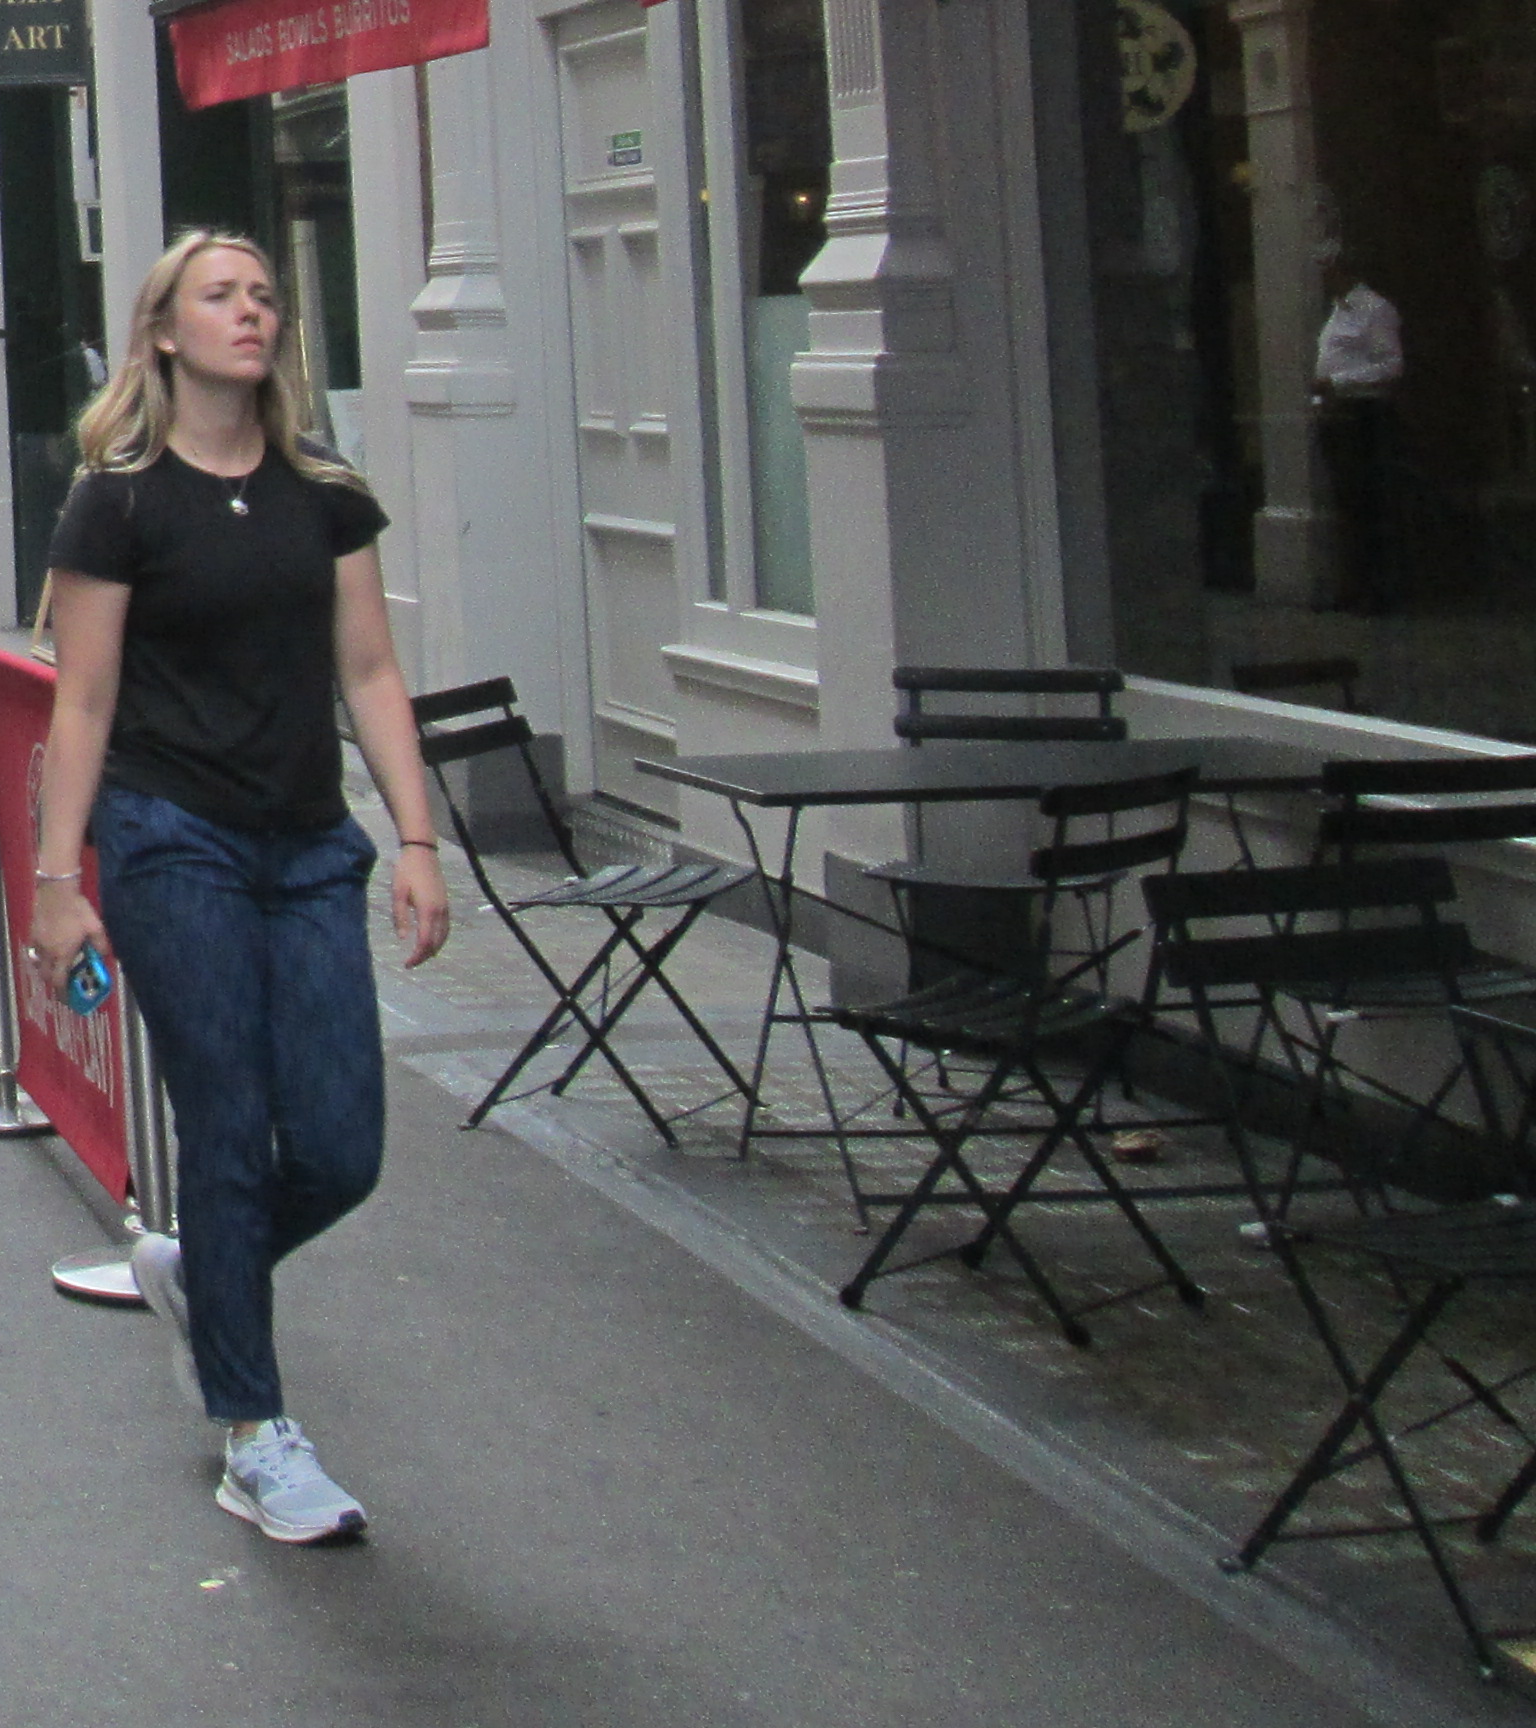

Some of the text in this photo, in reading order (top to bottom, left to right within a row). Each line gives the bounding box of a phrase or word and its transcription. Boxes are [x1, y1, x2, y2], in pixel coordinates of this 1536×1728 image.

[3, 25, 71, 52] ART
[226, 22, 273, 66] SALADS
[278, 6, 328, 53] BOWLS
